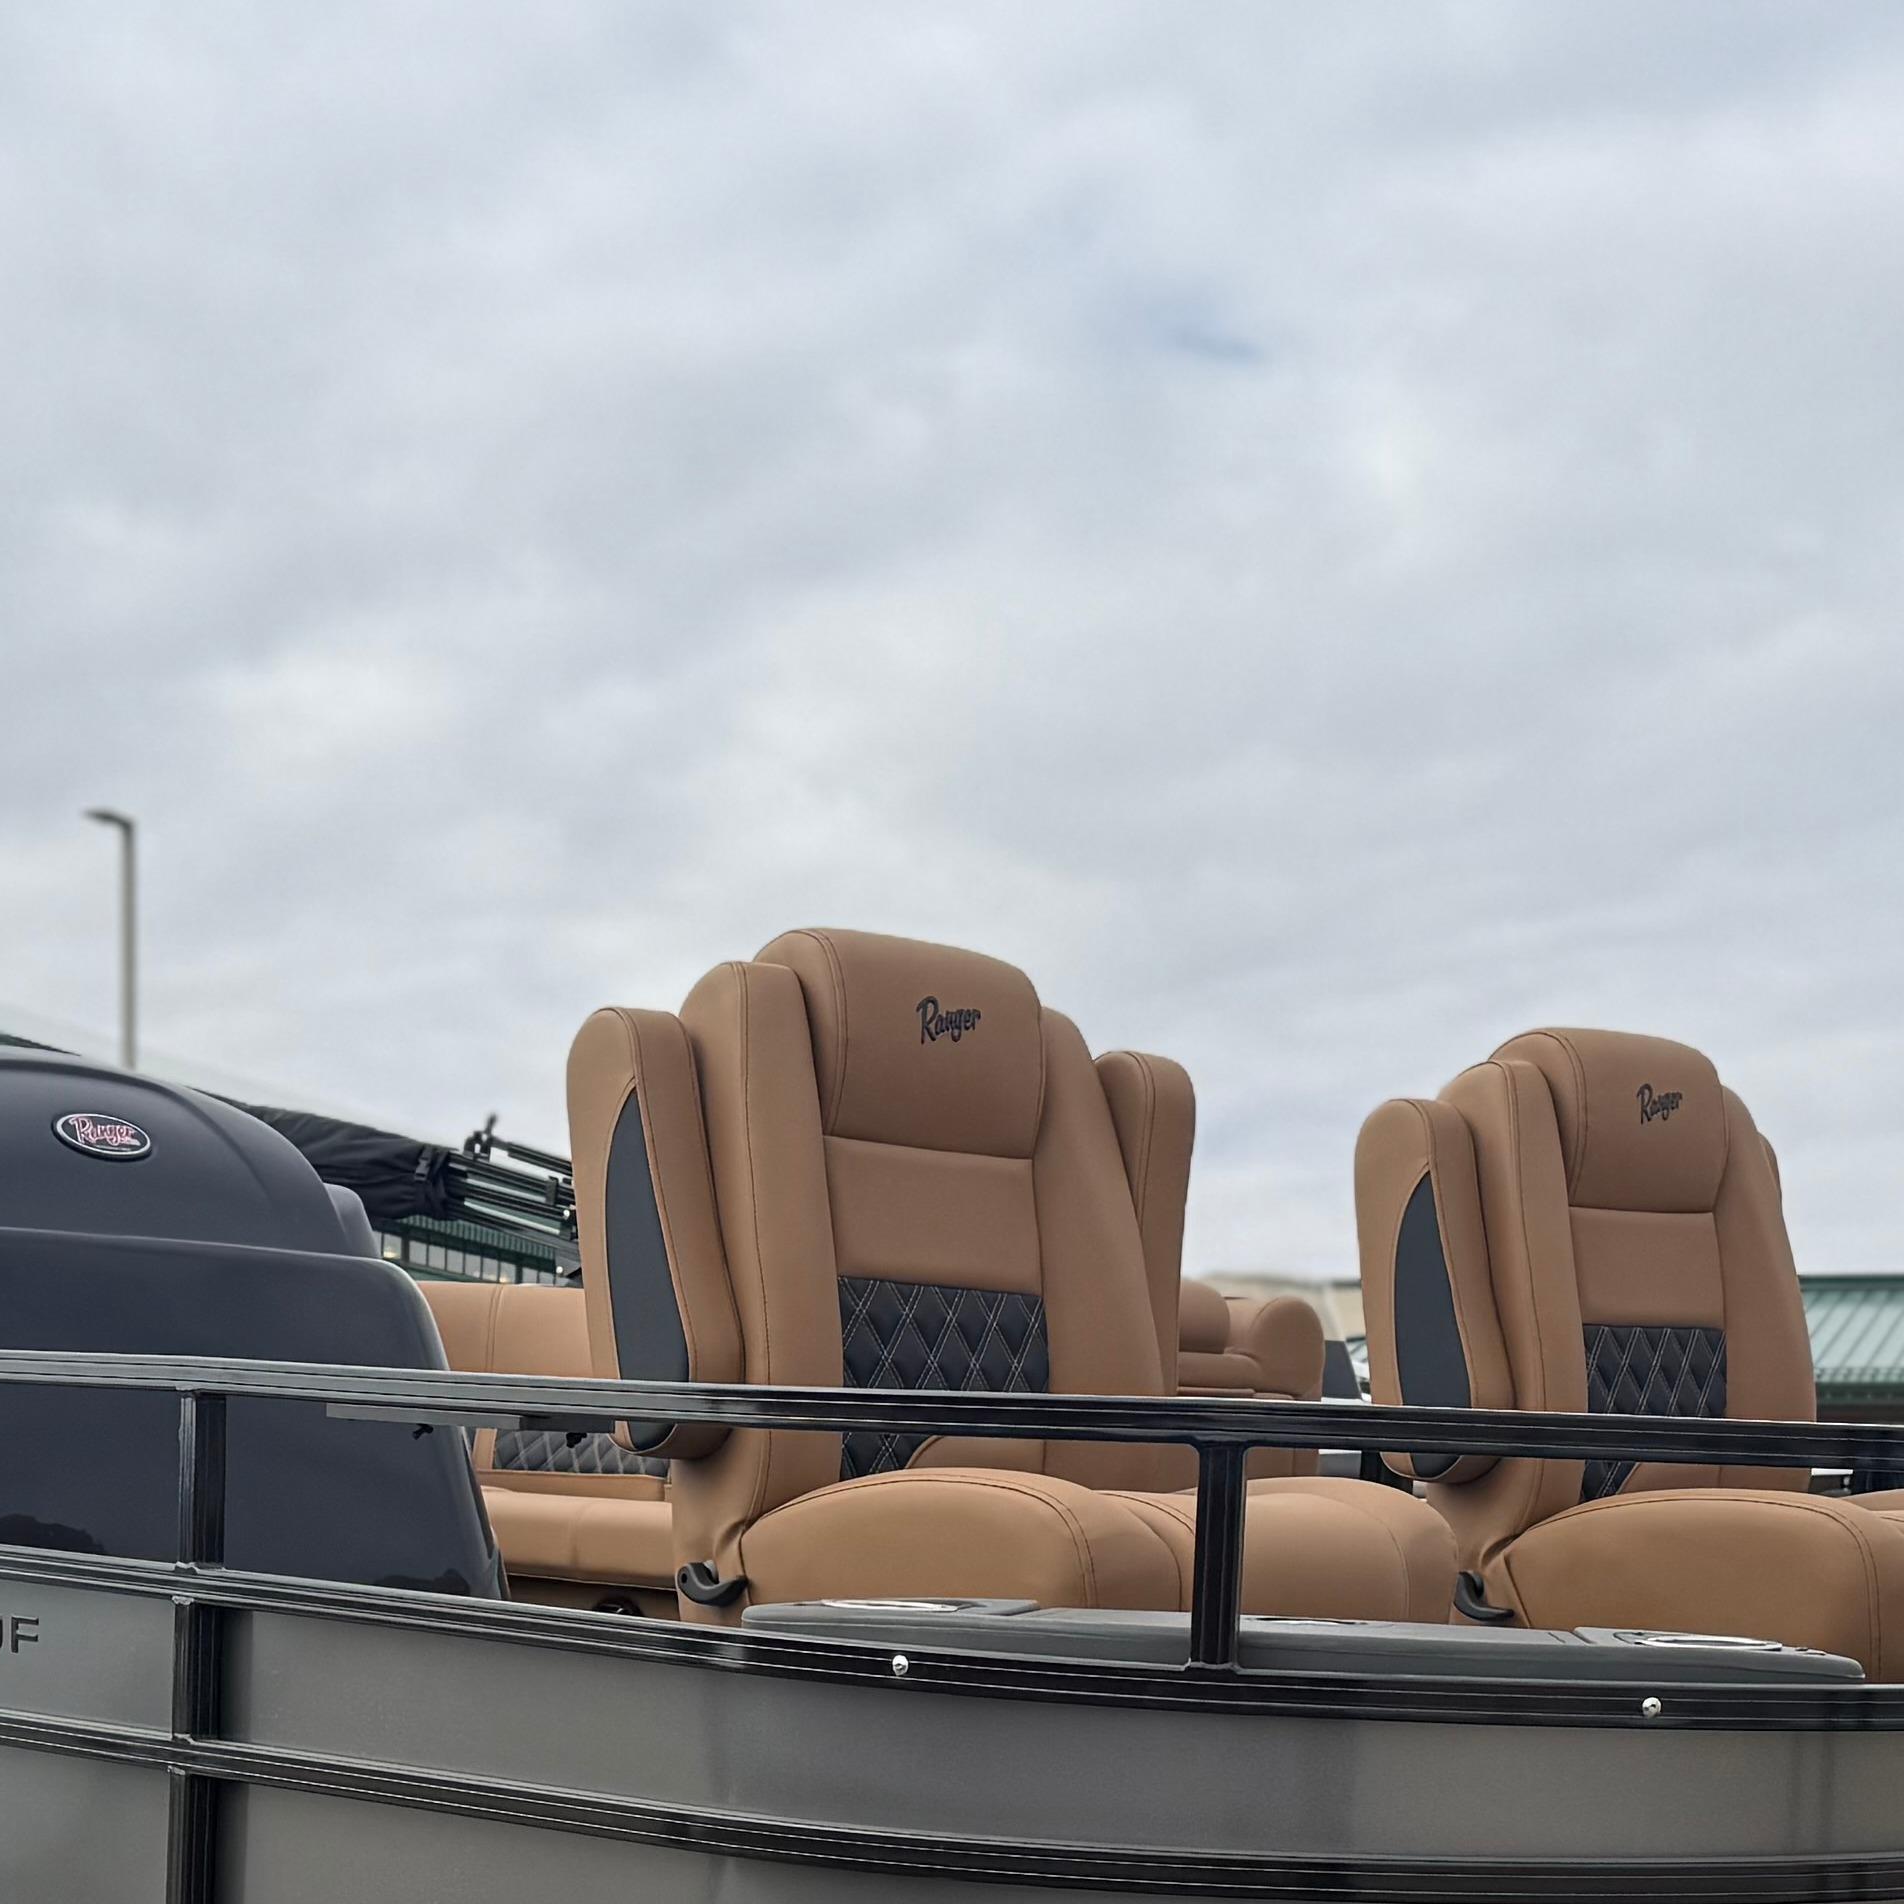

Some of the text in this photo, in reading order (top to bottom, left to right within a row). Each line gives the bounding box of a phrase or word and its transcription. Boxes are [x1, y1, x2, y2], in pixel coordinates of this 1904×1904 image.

[916, 995, 981, 1044] Ranger
[1636, 1083, 1683, 1125] Ranger
[68, 1117, 136, 1146] Ranger
